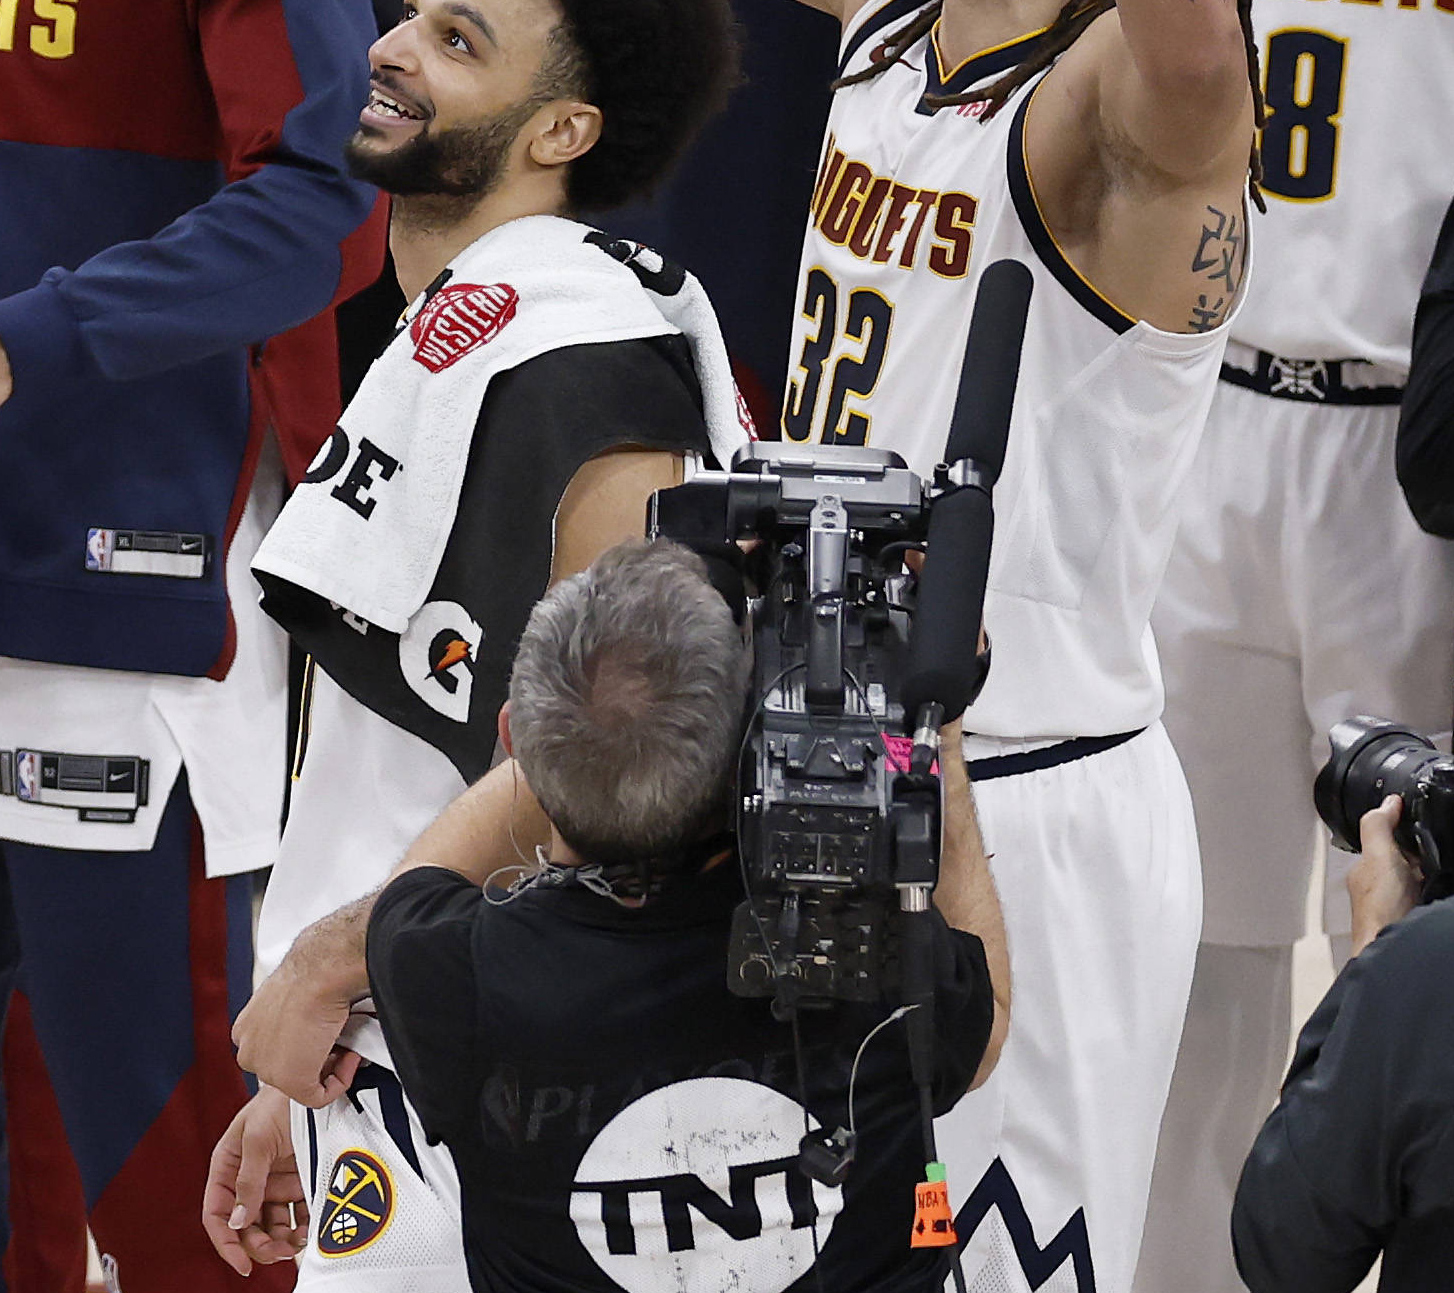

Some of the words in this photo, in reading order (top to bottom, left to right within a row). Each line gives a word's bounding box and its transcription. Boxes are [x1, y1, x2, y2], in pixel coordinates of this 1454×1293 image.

[418, 284, 510, 367] WESTERN
[781, 263, 895, 447] 32
[398, 601, 485, 723] G
[570, 1153, 824, 1257] TNT
